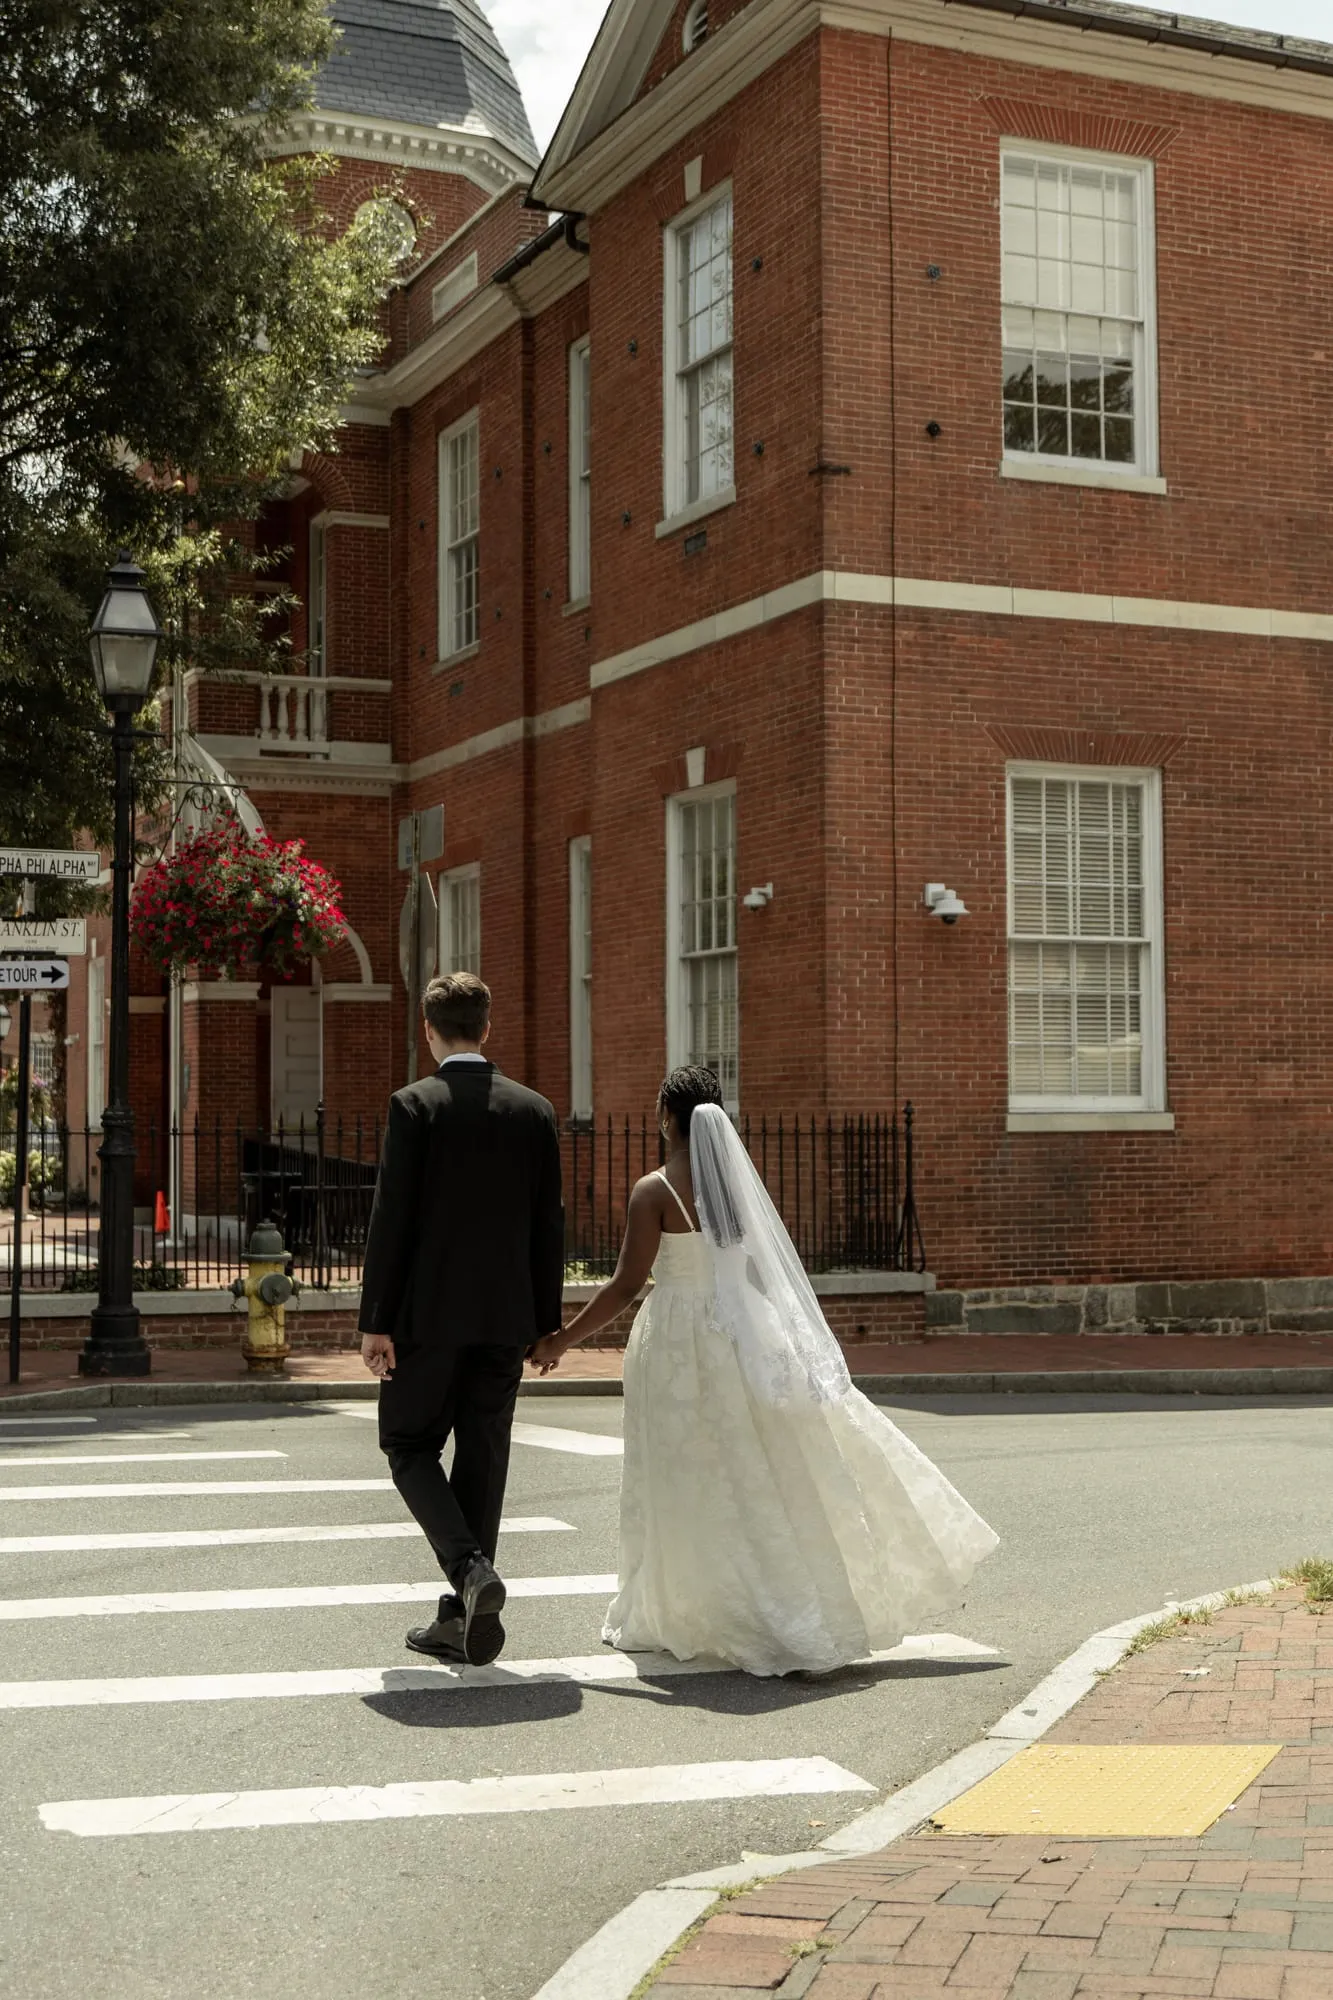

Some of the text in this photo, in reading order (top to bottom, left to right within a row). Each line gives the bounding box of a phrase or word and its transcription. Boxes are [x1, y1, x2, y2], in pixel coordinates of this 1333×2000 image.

[27, 858, 45, 874] PHI
[49, 859, 86, 875] ALPHA
[61, 921, 81, 937] ST.
[0, 967, 37, 983] ETOUR
